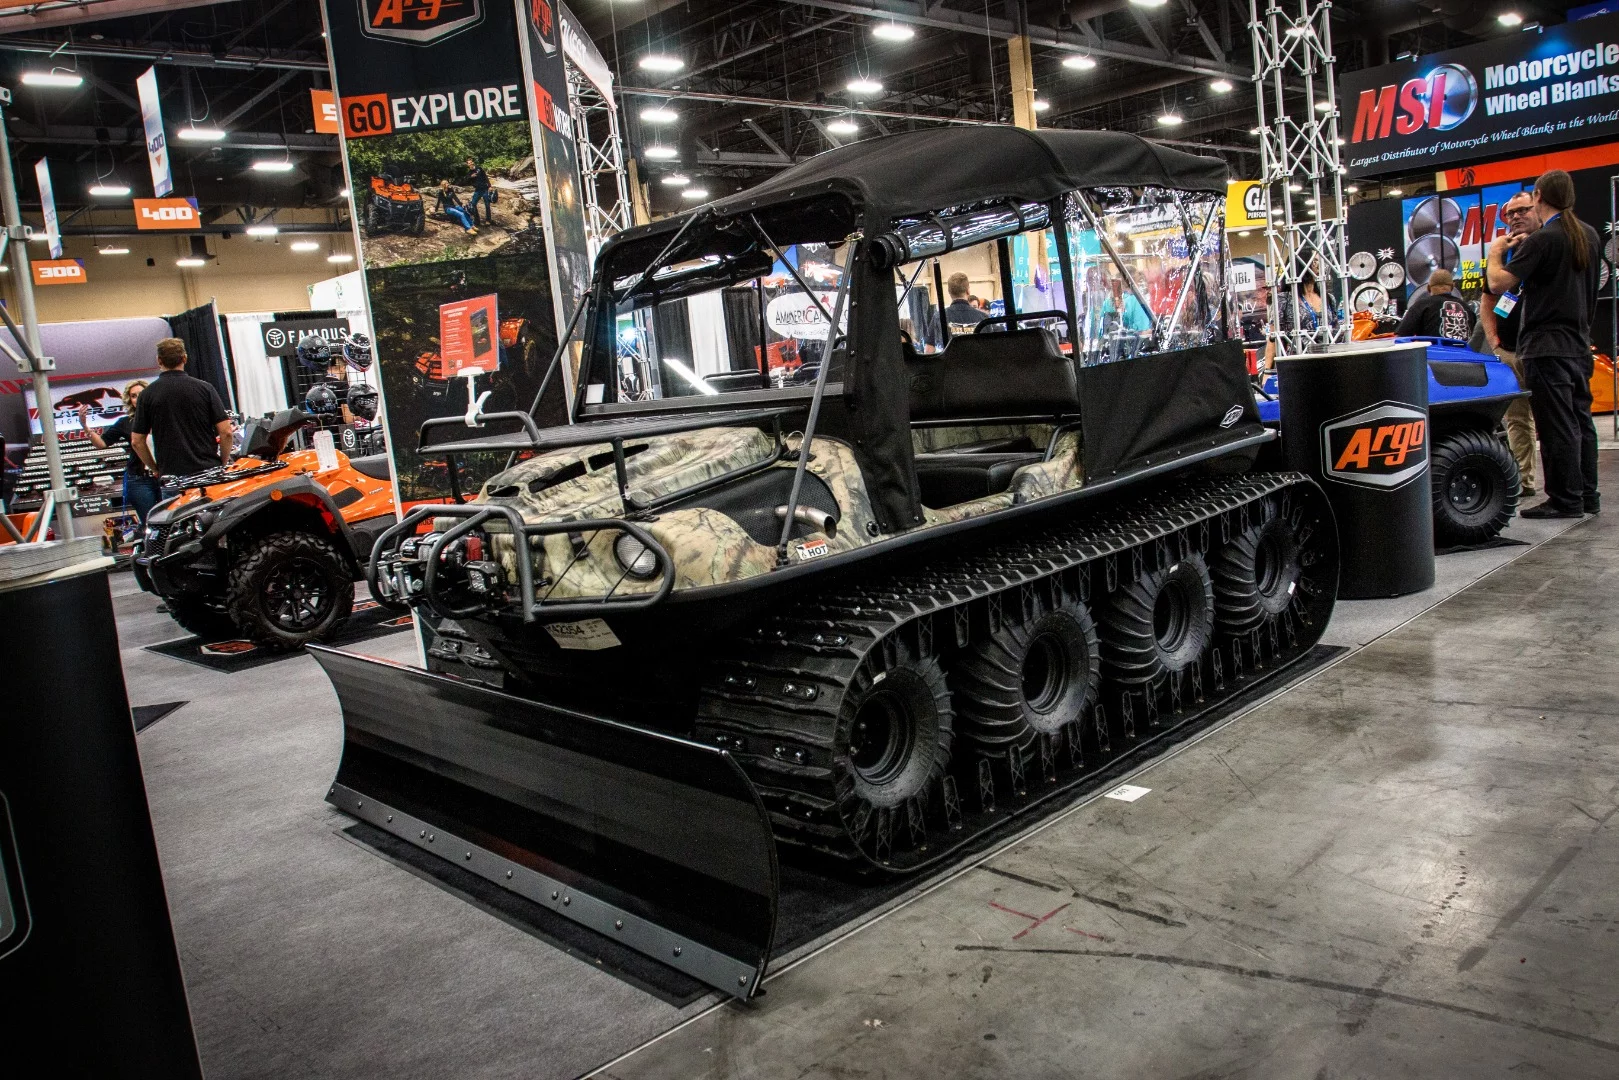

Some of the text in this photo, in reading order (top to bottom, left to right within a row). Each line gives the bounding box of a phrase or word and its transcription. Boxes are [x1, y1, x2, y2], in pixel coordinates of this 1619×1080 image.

[1485, 42, 1619, 90] Motorcycle
[347, 84, 522, 133] GO EXPLORE
[1352, 72, 1447, 144] MSI
[1485, 74, 1619, 116] Wheel Blanks
[1350, 154, 1379, 168] Largest
[1381, 144, 1428, 162] Distributor
[1429, 142, 1441, 155] of
[1440, 135, 1488, 153] Motorcycle
[1490, 127, 1520, 142] Wheel
[1521, 121, 1555, 137] Blanks
[1556, 121, 1567, 131] in
[1569, 116, 1584, 128] the
[141, 207, 193, 221] 400
[39, 265, 81, 278] 300
[1462, 260, 1475, 270] We
[1462, 269, 1480, 281] You
[1461, 278, 1476, 290] for
[1334, 420, 1425, 470] Argo
[808, 545, 827, 557] HOT
